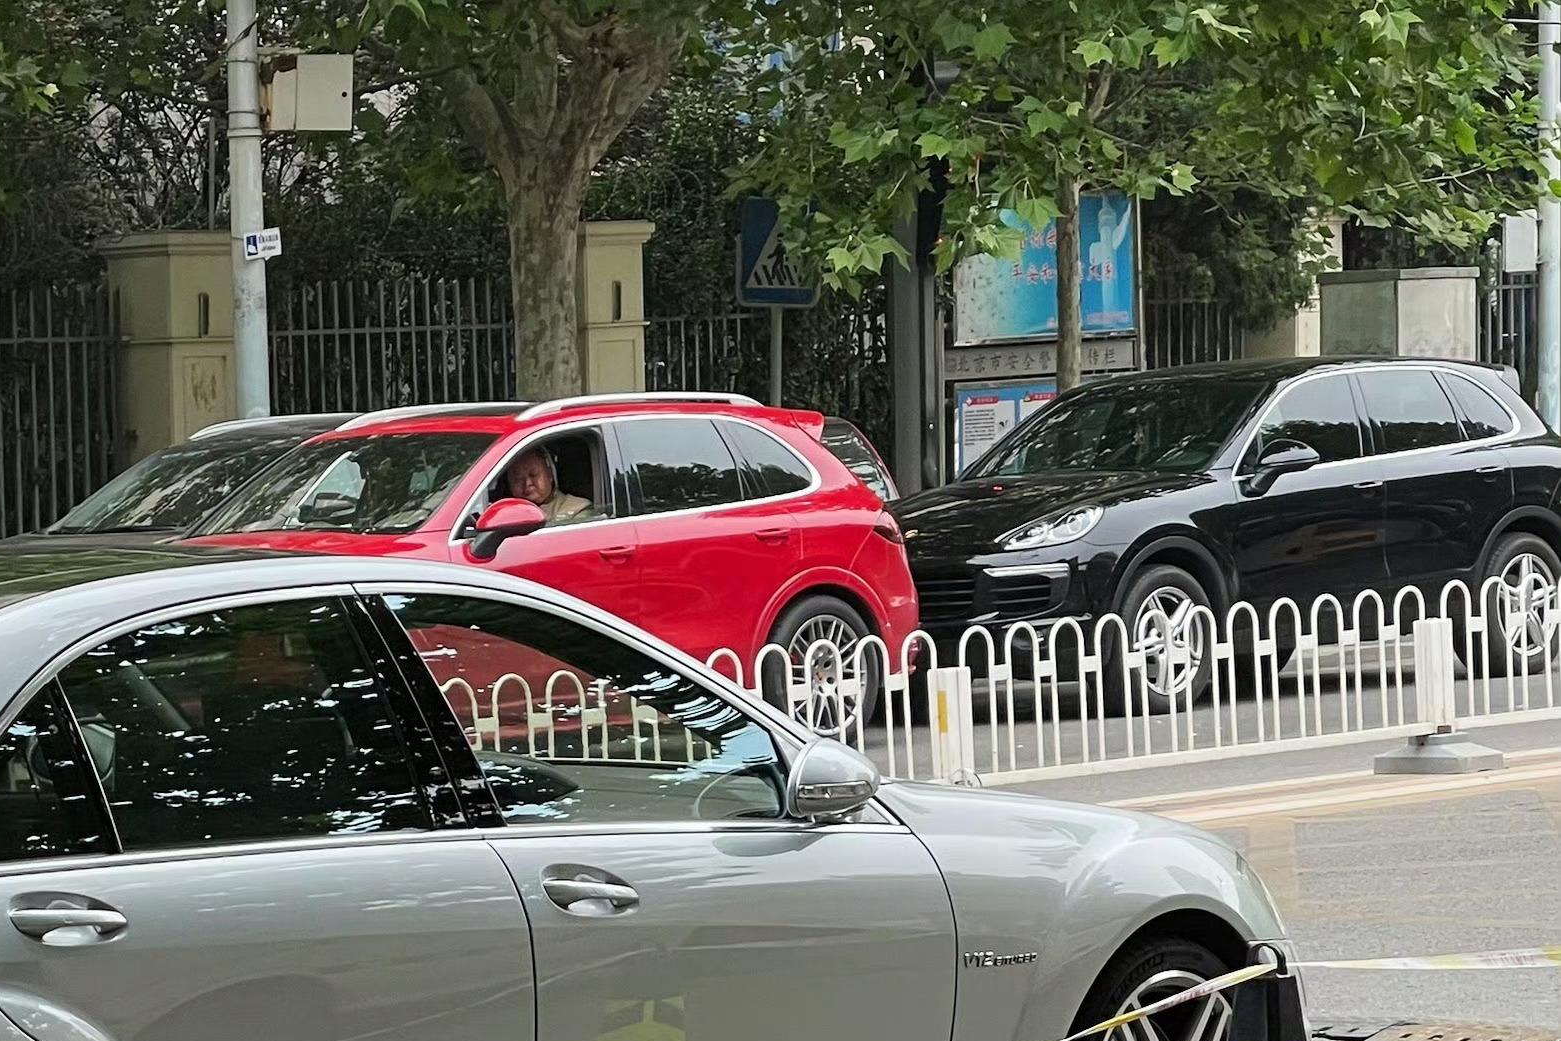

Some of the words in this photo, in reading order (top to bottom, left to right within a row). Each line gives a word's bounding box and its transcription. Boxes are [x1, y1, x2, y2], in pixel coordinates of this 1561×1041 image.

[957, 347, 1116, 373] 北京市安全警传栏
